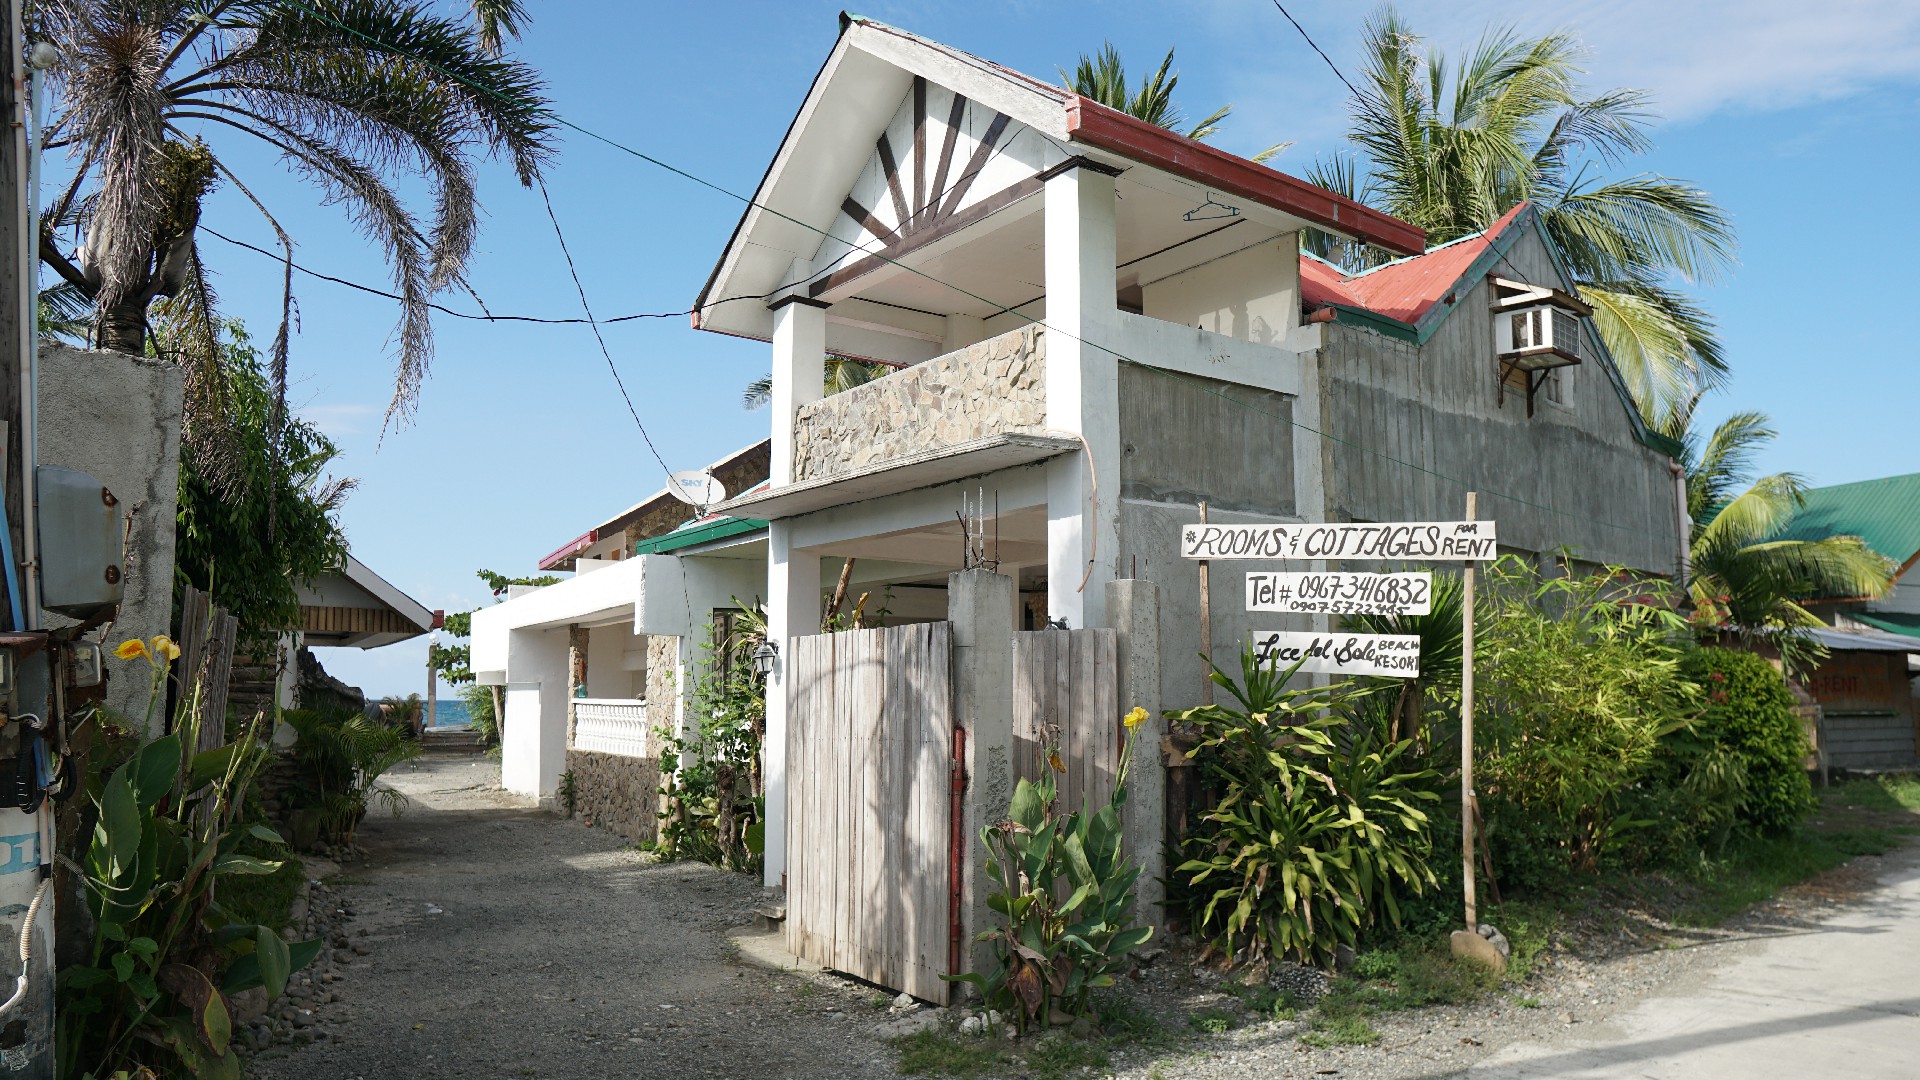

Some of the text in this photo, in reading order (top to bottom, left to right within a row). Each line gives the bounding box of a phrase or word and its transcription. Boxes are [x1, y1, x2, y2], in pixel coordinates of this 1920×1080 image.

[682, 479, 702, 487] SKY
[1454, 523, 1478, 536] FOR
[1304, 526, 1441, 557] COTTAGES
[1441, 537, 1497, 557] RENT
[1304, 638, 1333, 660] del
[1334, 638, 1376, 667] Sole
